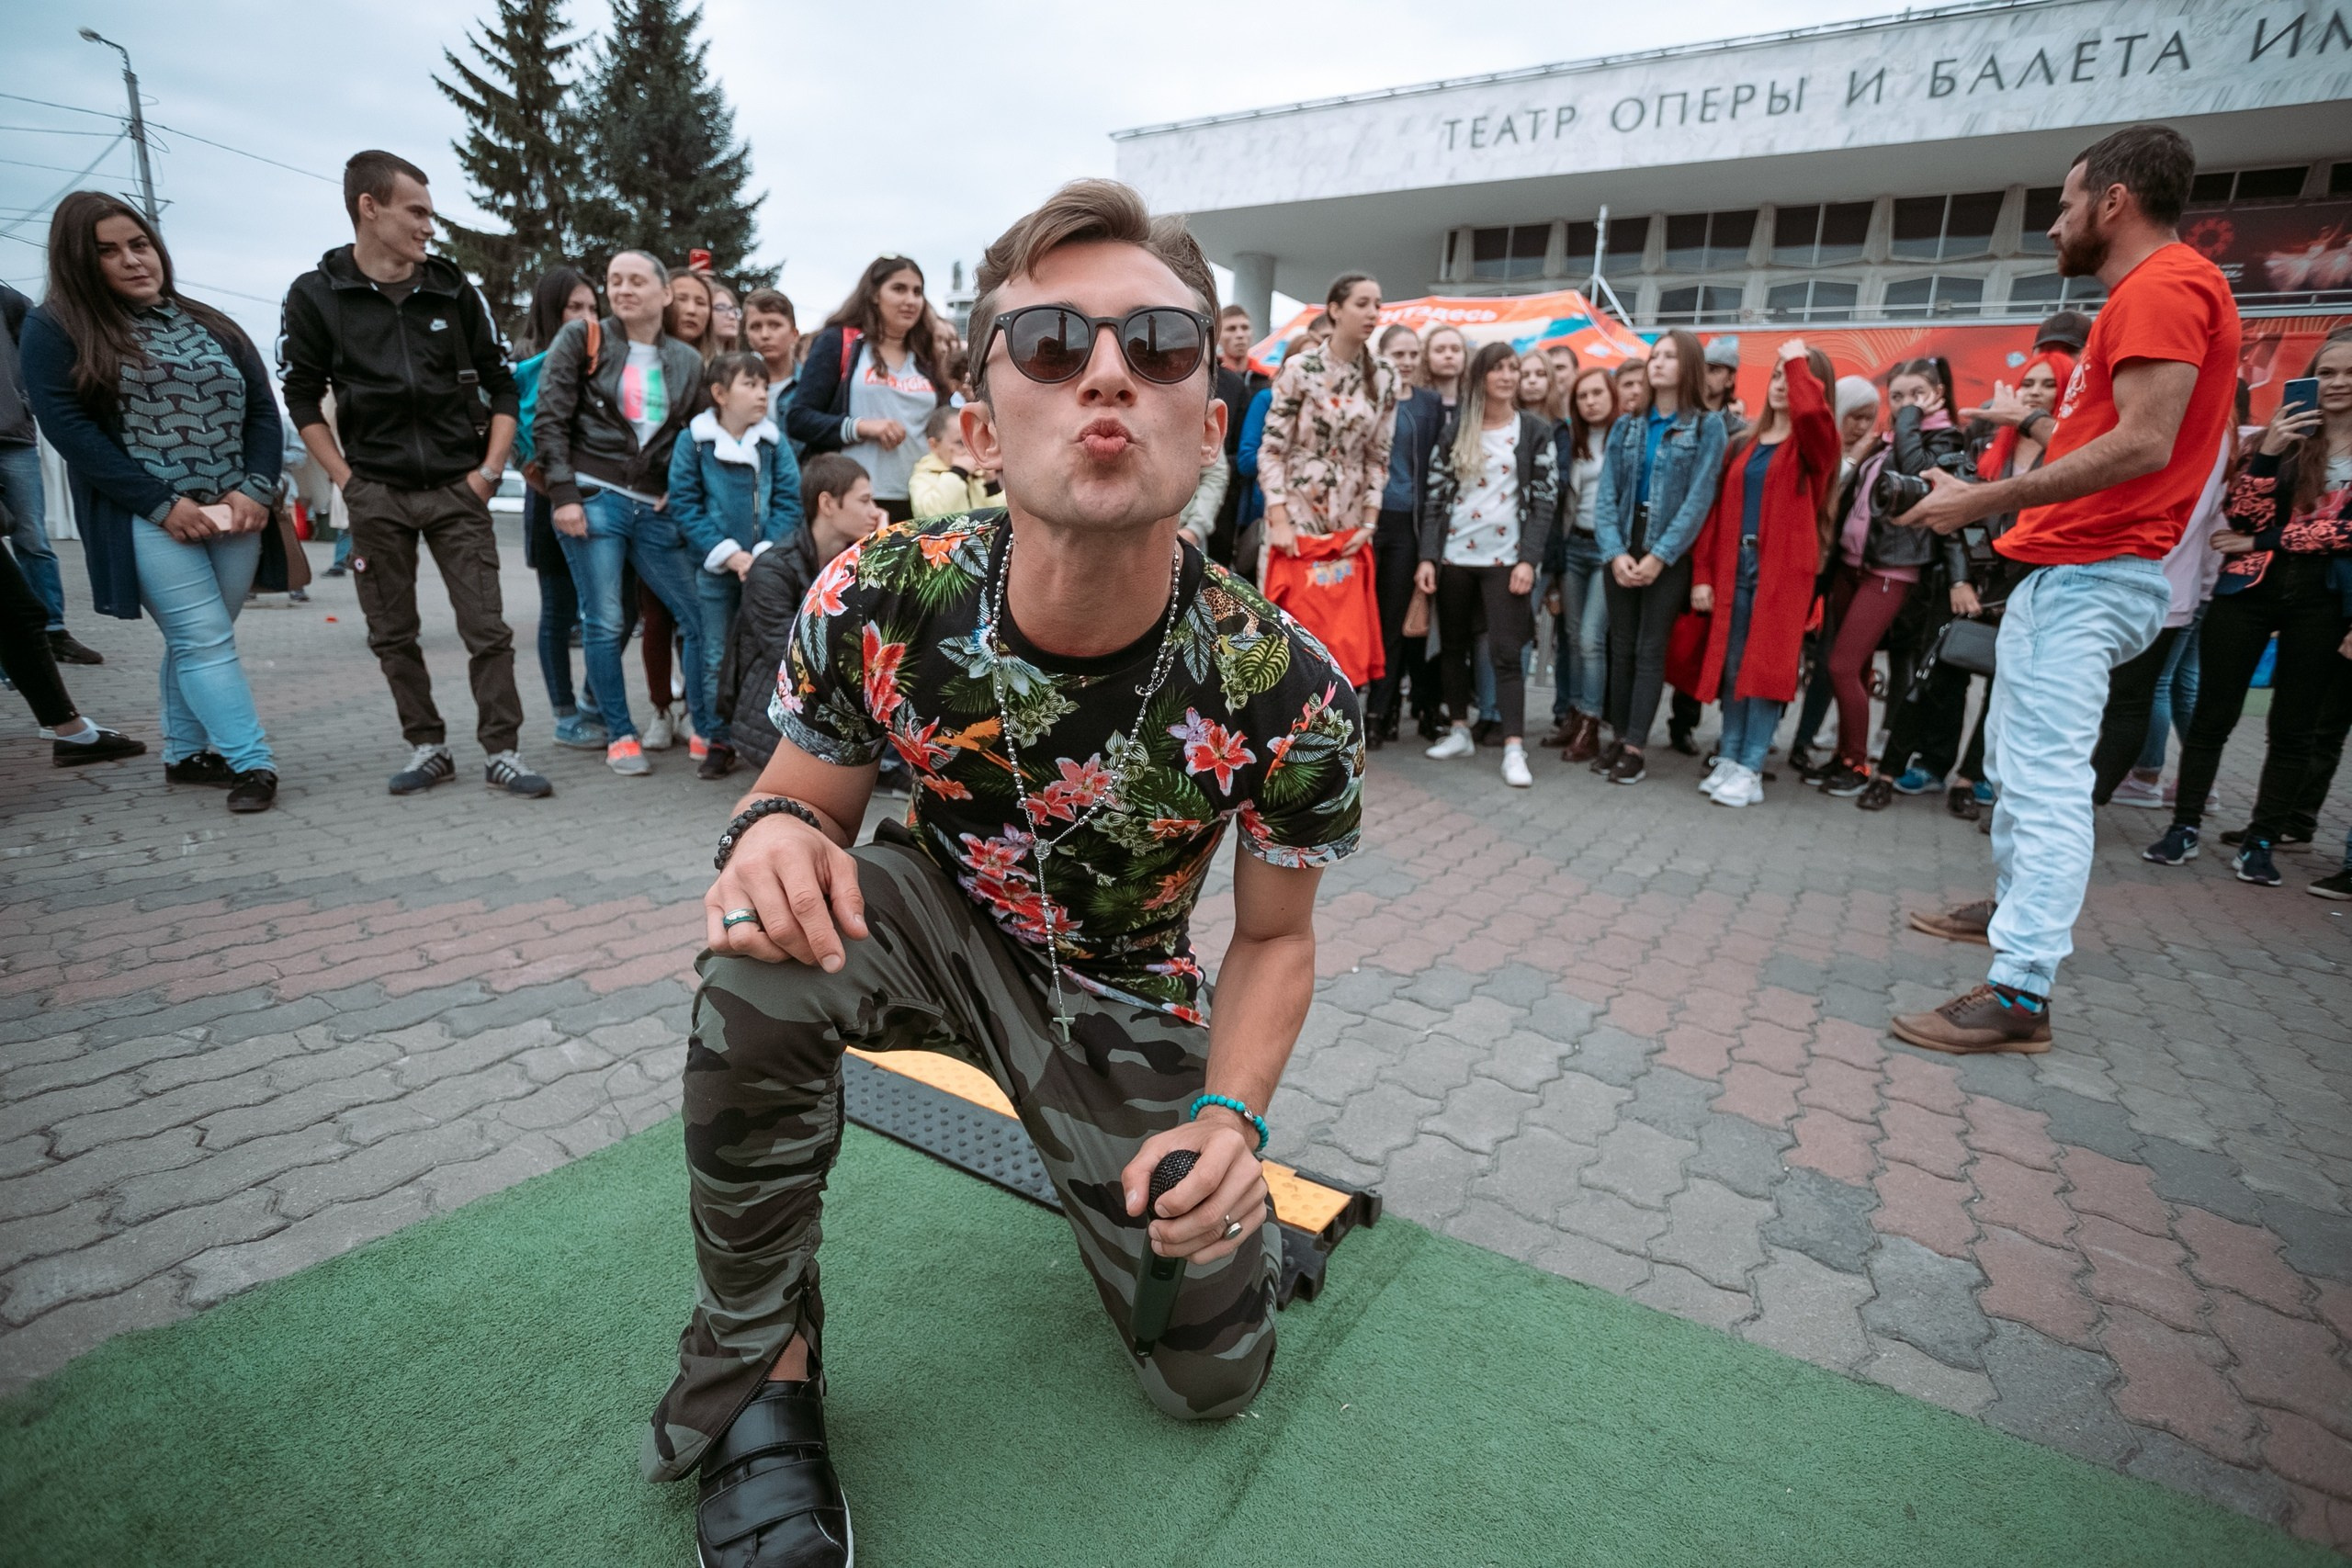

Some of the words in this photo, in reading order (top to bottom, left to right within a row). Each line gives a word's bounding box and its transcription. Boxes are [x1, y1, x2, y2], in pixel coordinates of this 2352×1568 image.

[1443, 106, 1577, 151] ТЕАТР
[1610, 76, 1808, 133] ОПЕРЫ
[1845, 67, 1886, 108] И
[1928, 29, 2190, 99] БАЛЕТА
